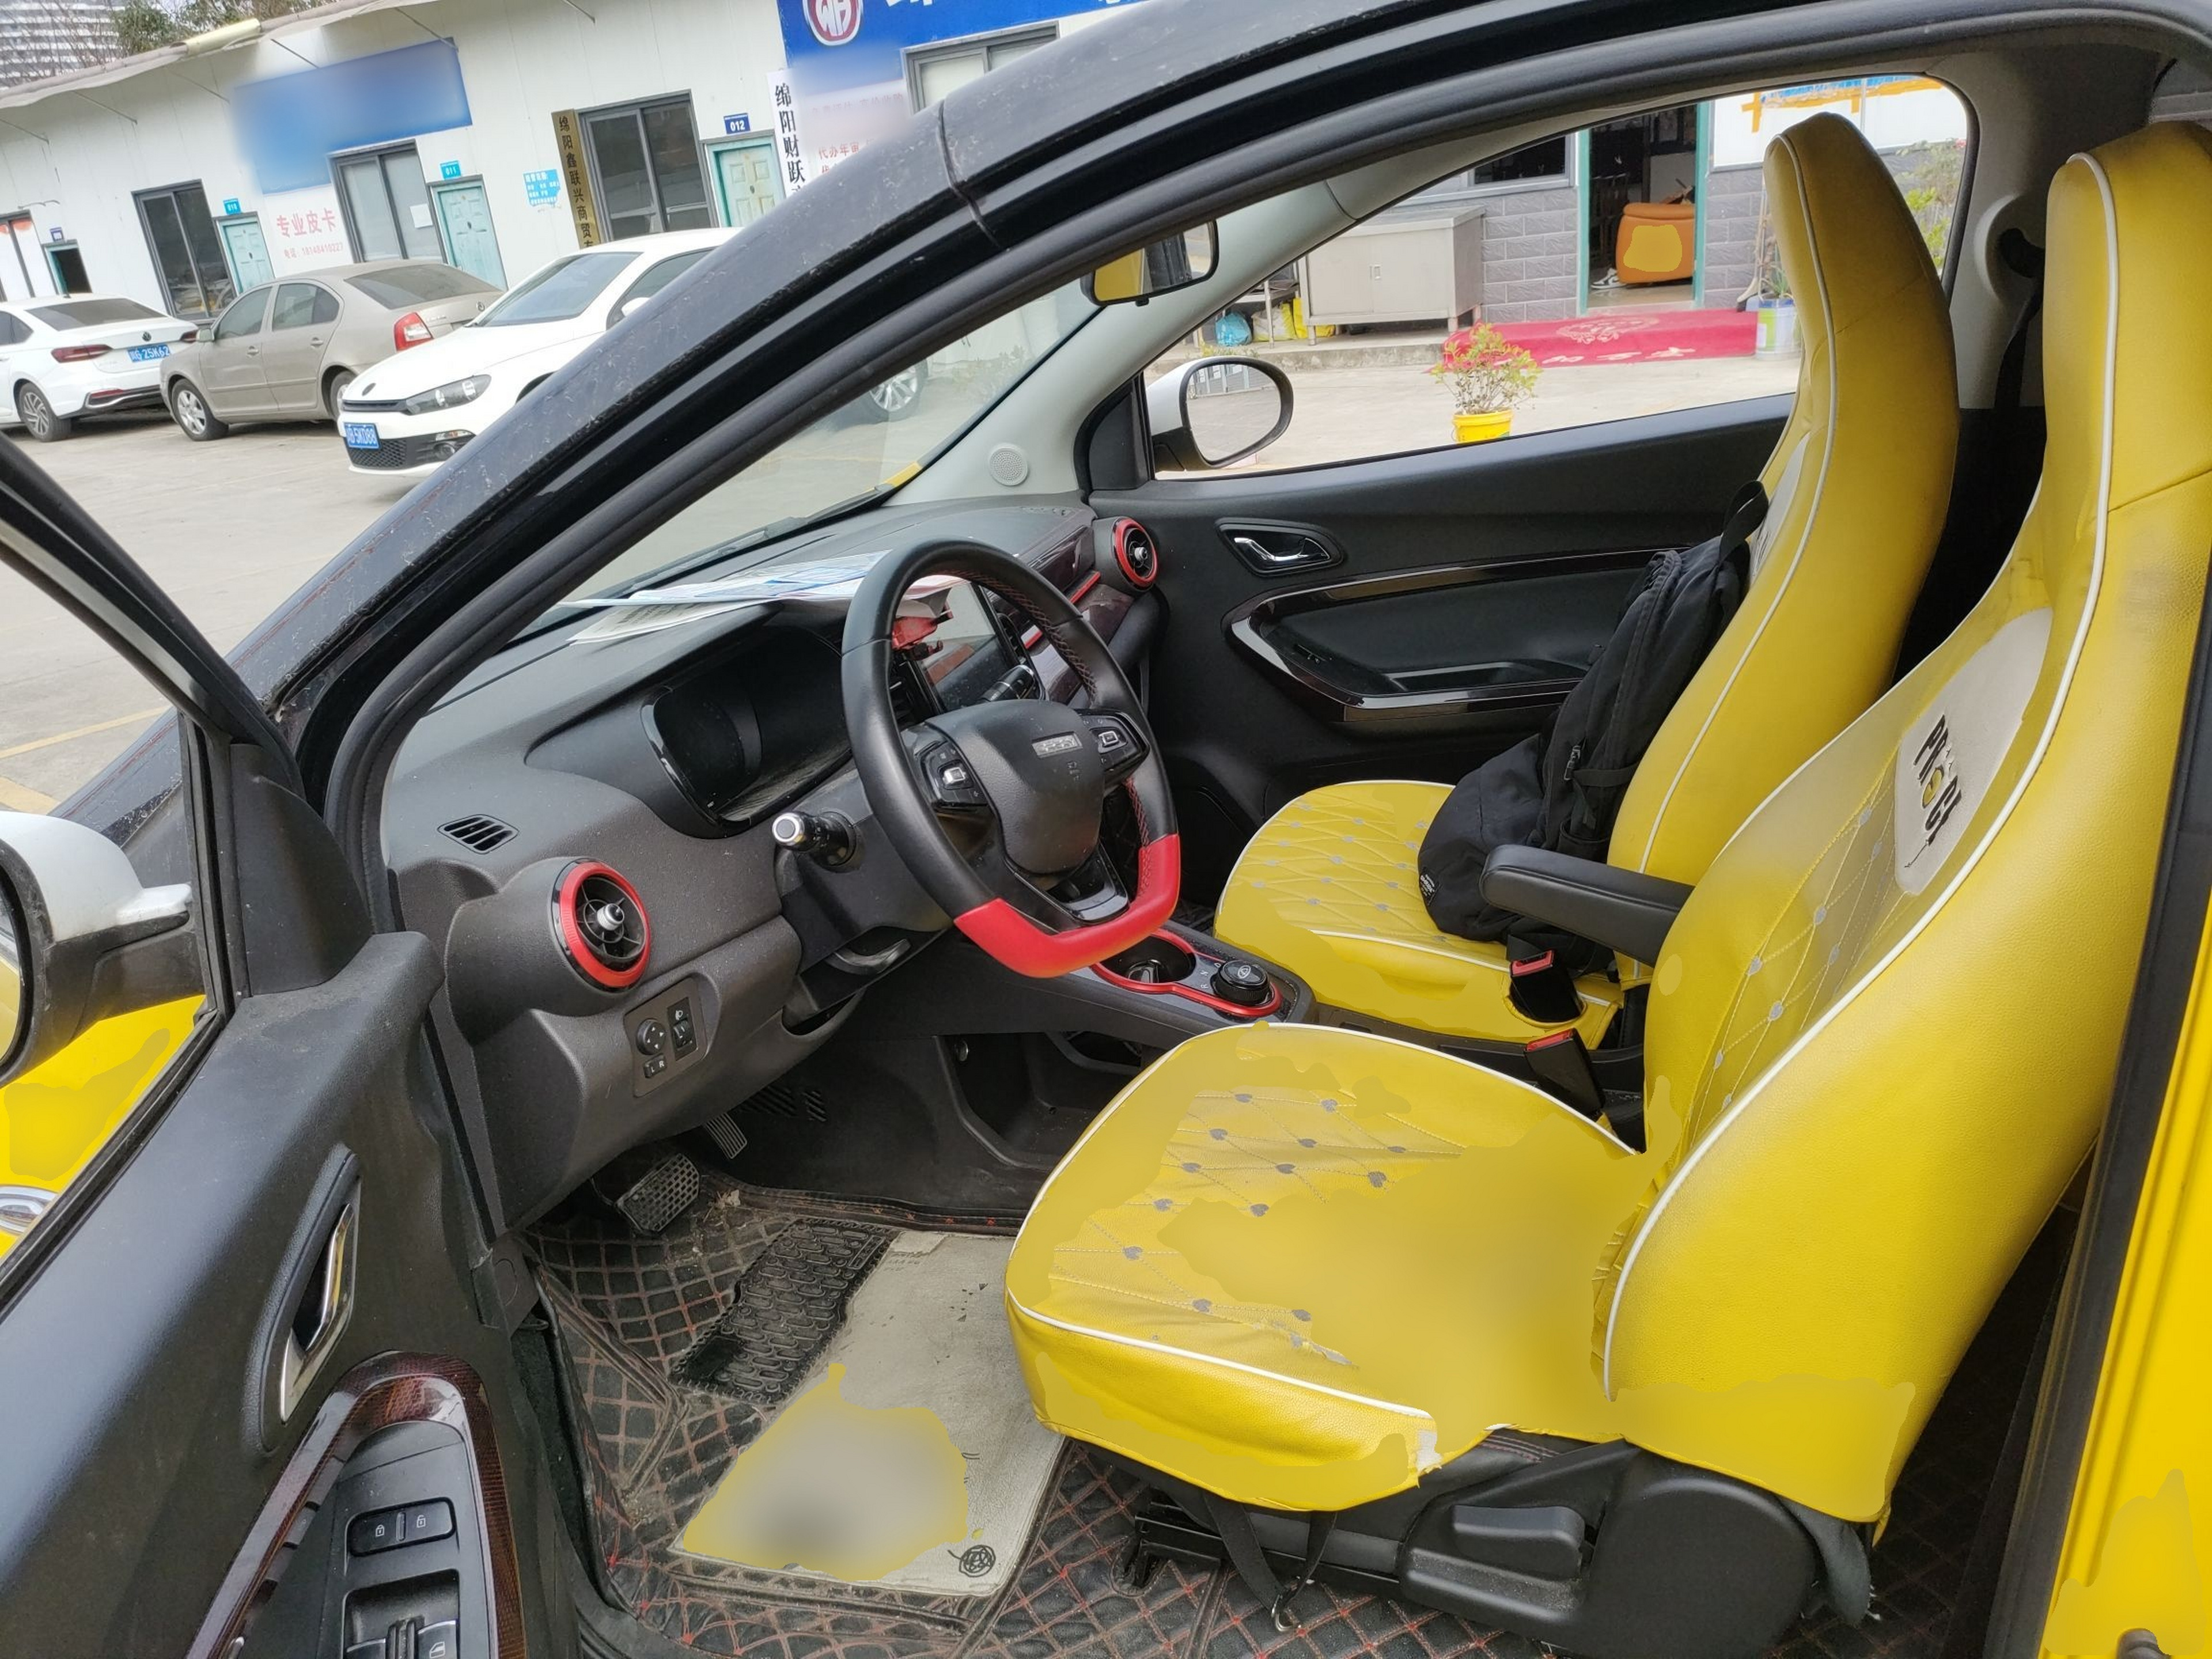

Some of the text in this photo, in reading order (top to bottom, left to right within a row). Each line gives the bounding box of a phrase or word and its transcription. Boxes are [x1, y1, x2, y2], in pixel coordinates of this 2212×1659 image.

[730, 120, 745, 132] 012
[775, 83, 806, 191] 绵阳财跃
[276, 207, 336, 238] 专业皮卡
